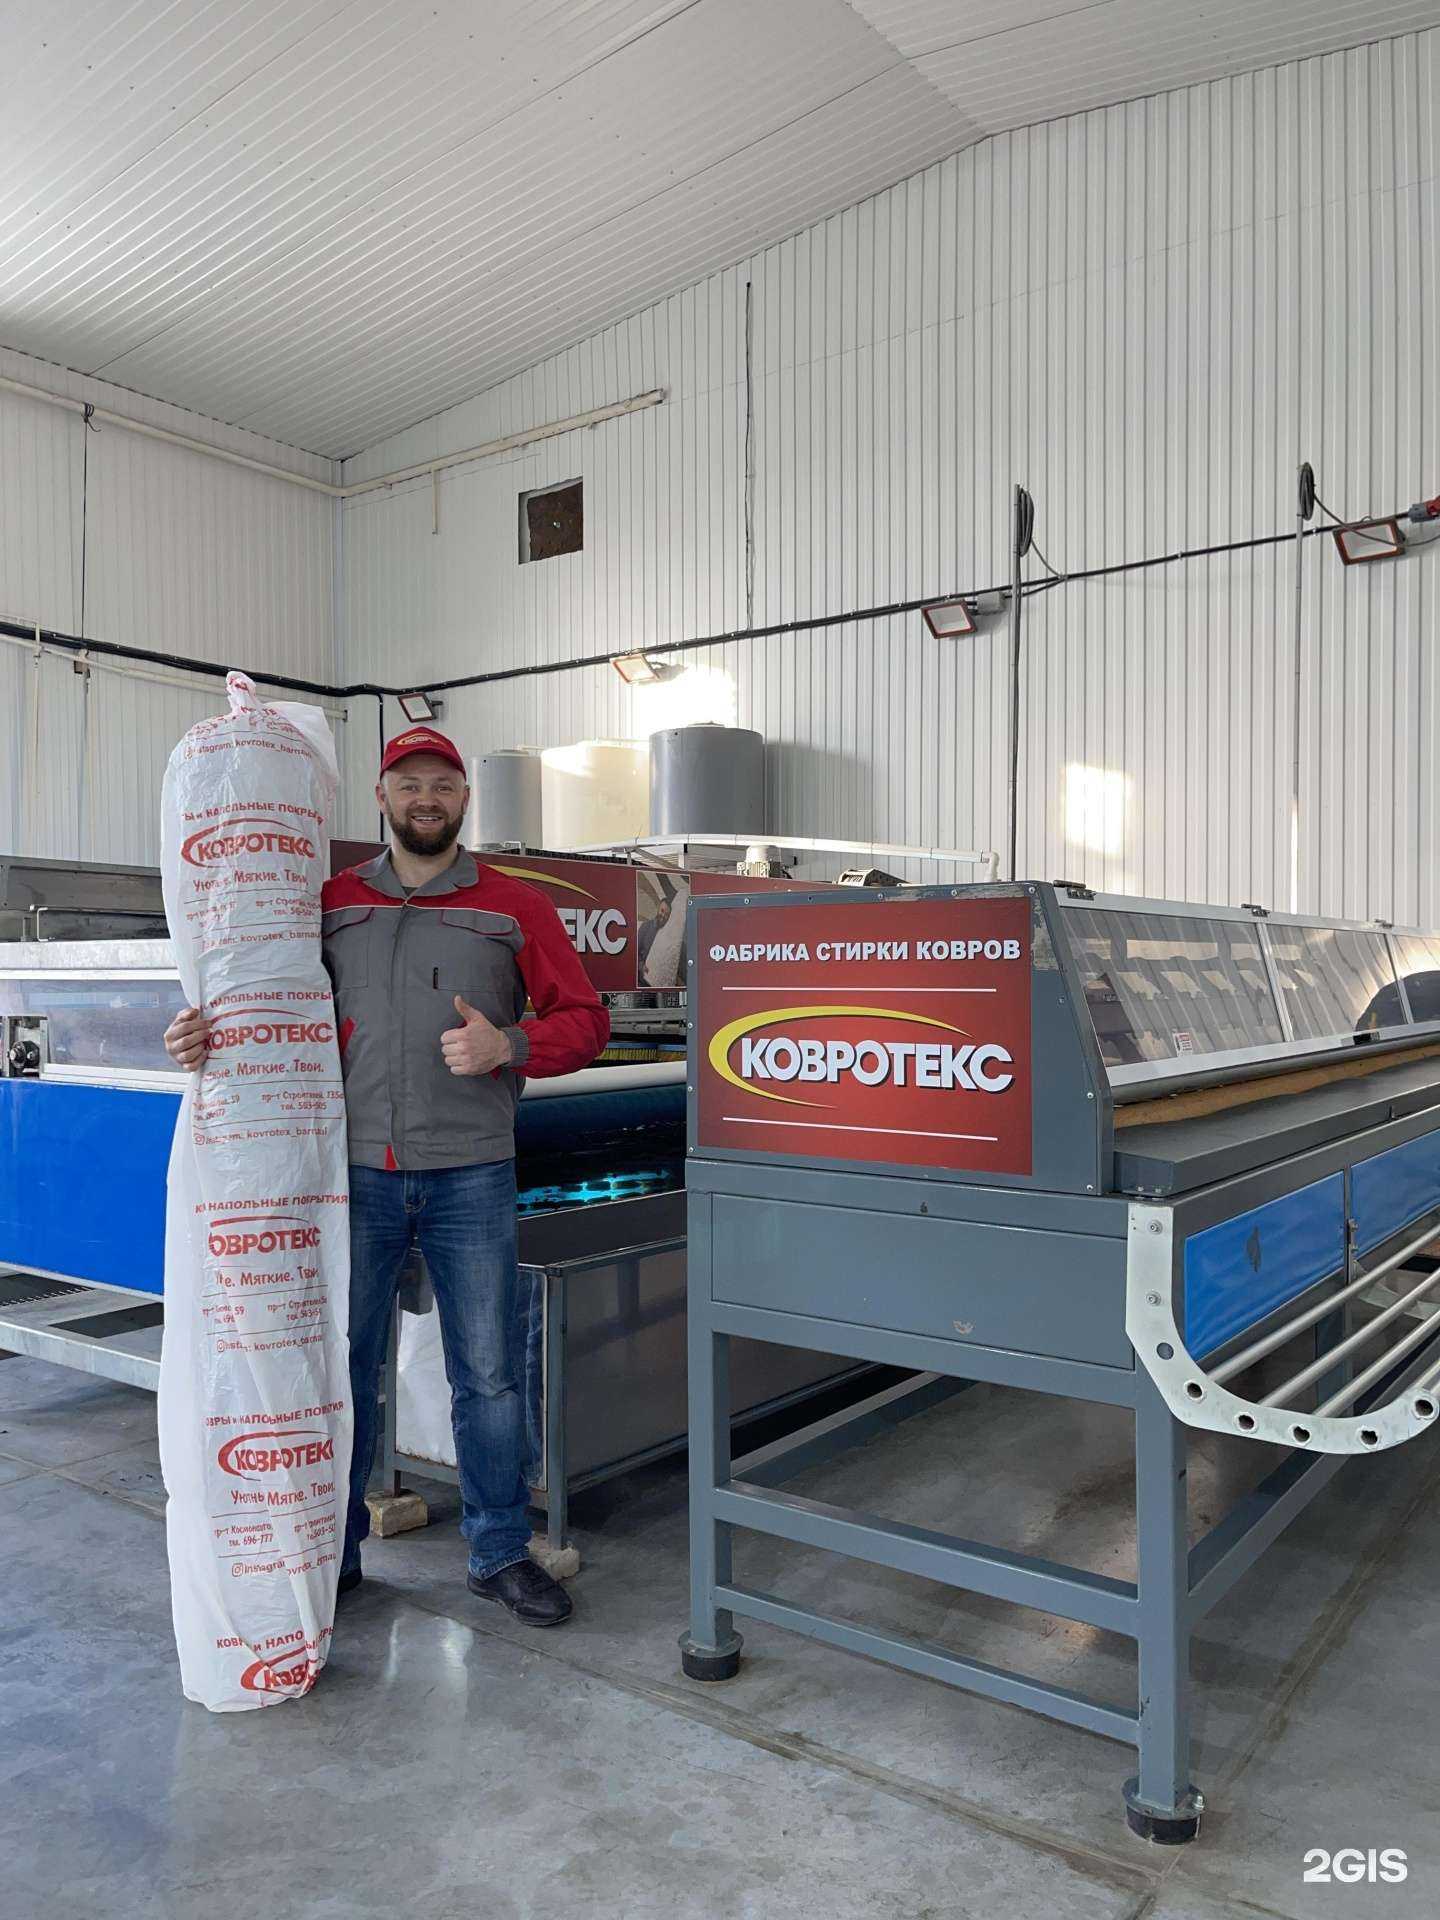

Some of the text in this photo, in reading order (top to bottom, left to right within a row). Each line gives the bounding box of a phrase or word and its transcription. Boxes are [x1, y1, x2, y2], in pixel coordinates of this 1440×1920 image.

[197, 832, 316, 862] КОВРОТЕКС
[234, 870, 281, 886] Мягкие.
[556, 908, 627, 955] ЕКС
[709, 939, 1021, 962] ФАБРИКА СТИРКИ КОВРОВ
[287, 991, 332, 1001] ПОКРЫ
[206, 1022, 333, 1051] ОВРОТЕКС
[237, 1061, 290, 1076] Мягкие.
[292, 1058, 324, 1074] Твои.
[741, 1036, 1014, 1093] КОВРОТЕКС
[208, 1197, 289, 1212] НАПОЛЬНЫЕ
[208, 1226, 321, 1257] ОВРОТЕКС
[240, 1271, 295, 1287] Мягкие.
[253, 1643, 262, 1652] и
